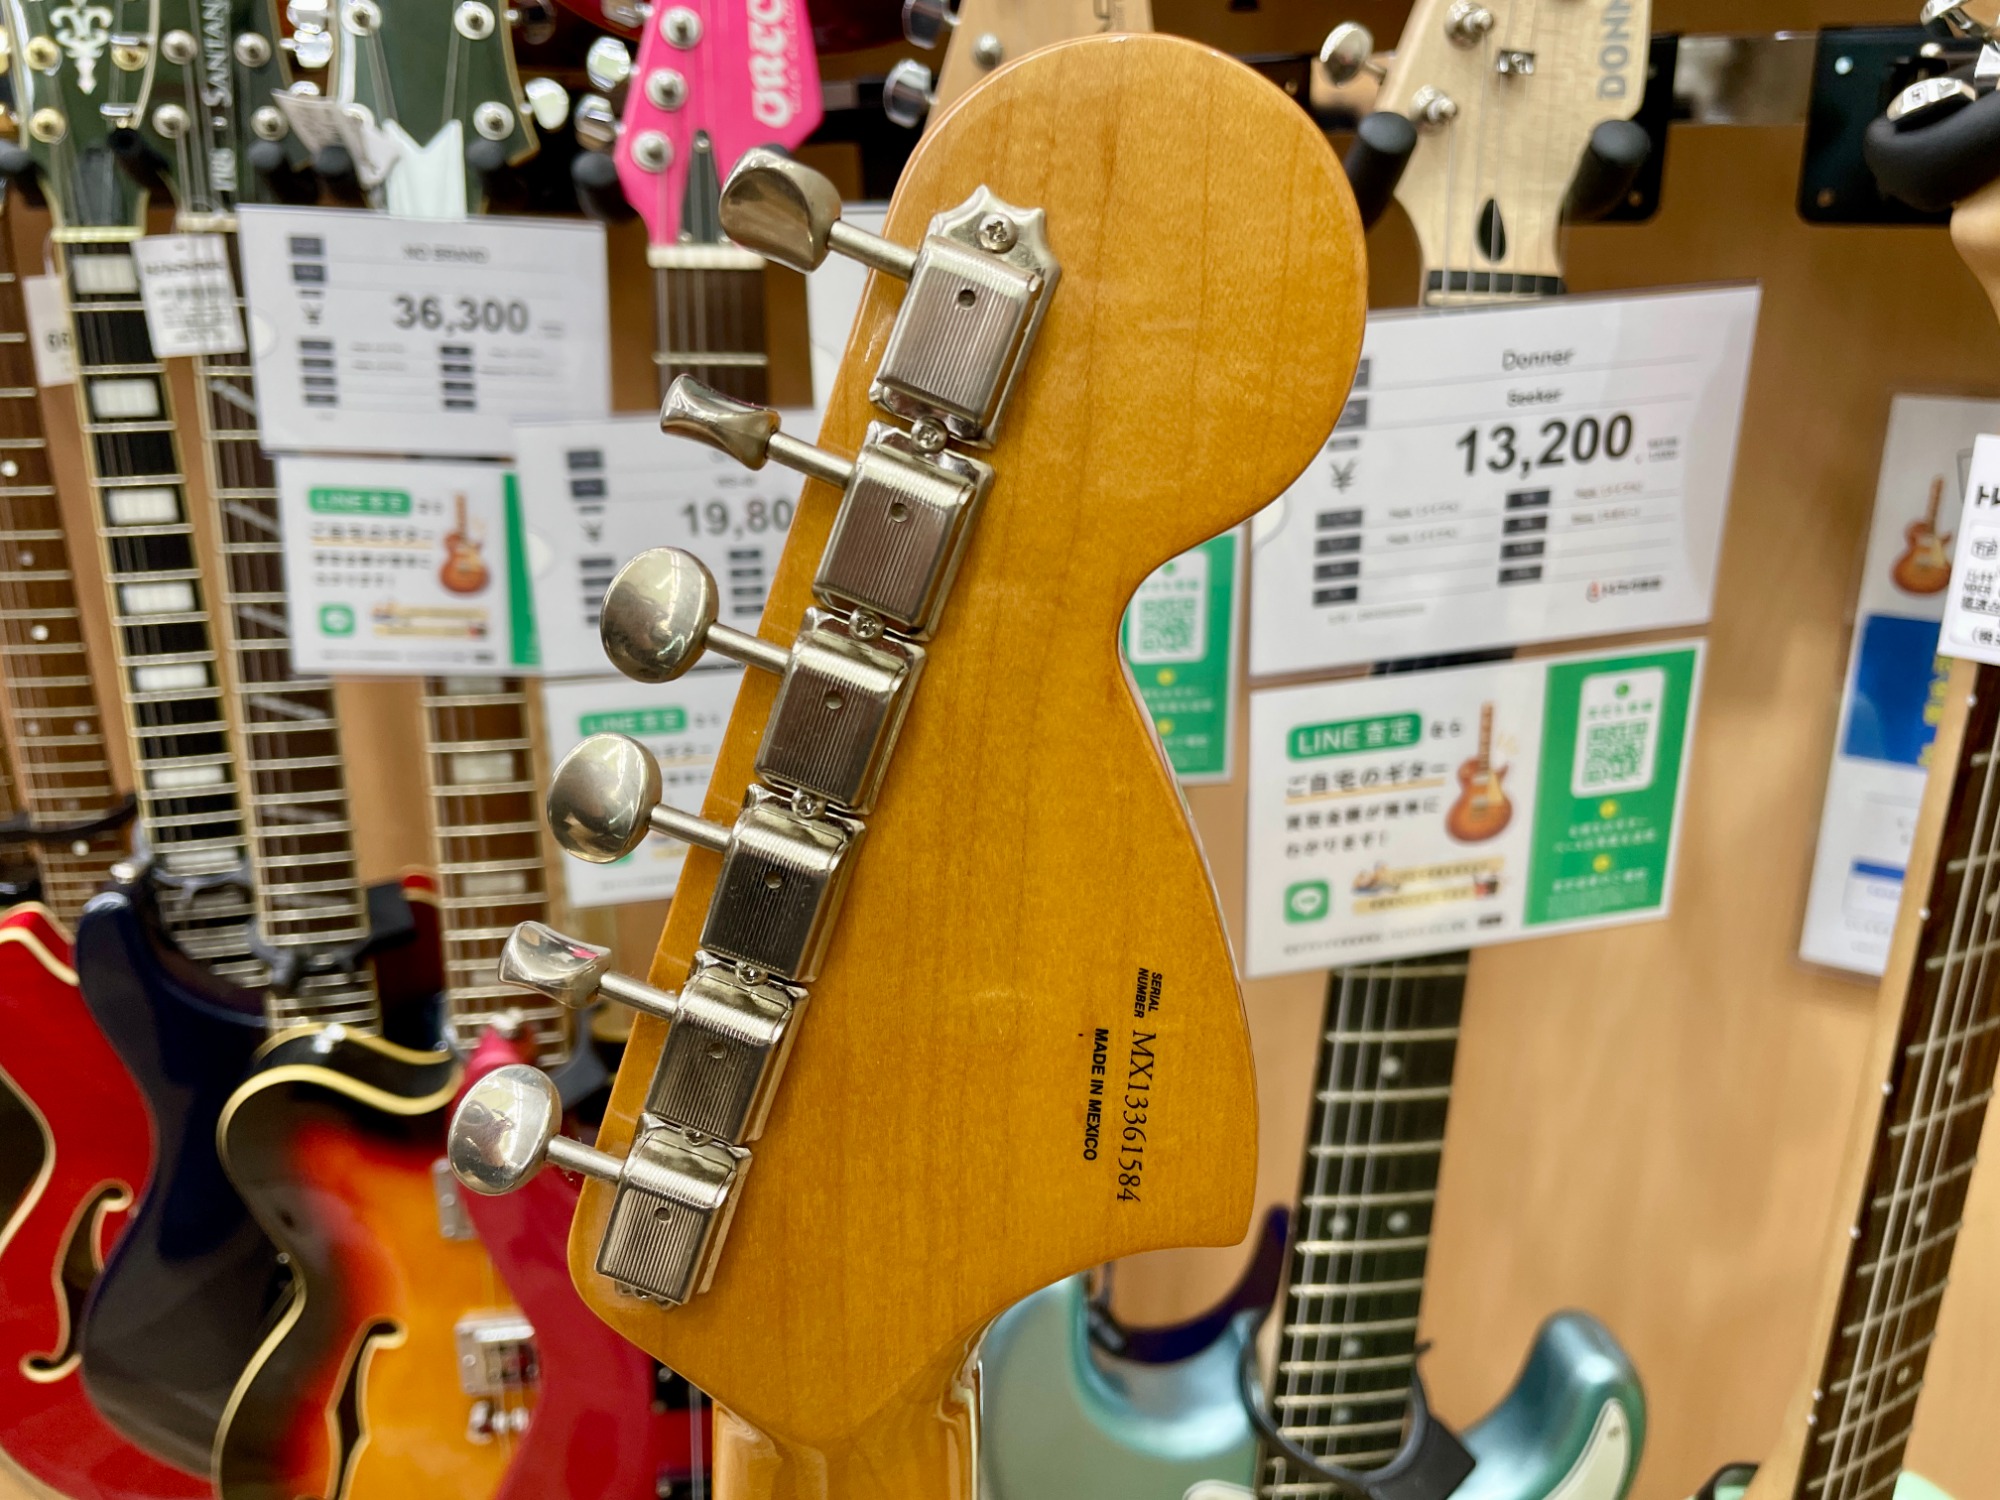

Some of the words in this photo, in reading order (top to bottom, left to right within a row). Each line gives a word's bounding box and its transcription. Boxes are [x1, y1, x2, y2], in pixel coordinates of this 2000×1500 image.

[393, 293, 530, 336] 36,300
[1503, 347, 1574, 370] Donner
[1457, 412, 1634, 478] 13,200
[1299, 727, 1359, 755] LINE
[1134, 967, 1149, 1018] NUMBER
[1148, 972, 1162, 1012] SERIAL
[1091, 1028, 1109, 1075] MADE
[1090, 1079, 1104, 1095] IN
[1083, 1099, 1102, 1161] MEXICO
[1117, 1030, 1156, 1201] MX13361584
